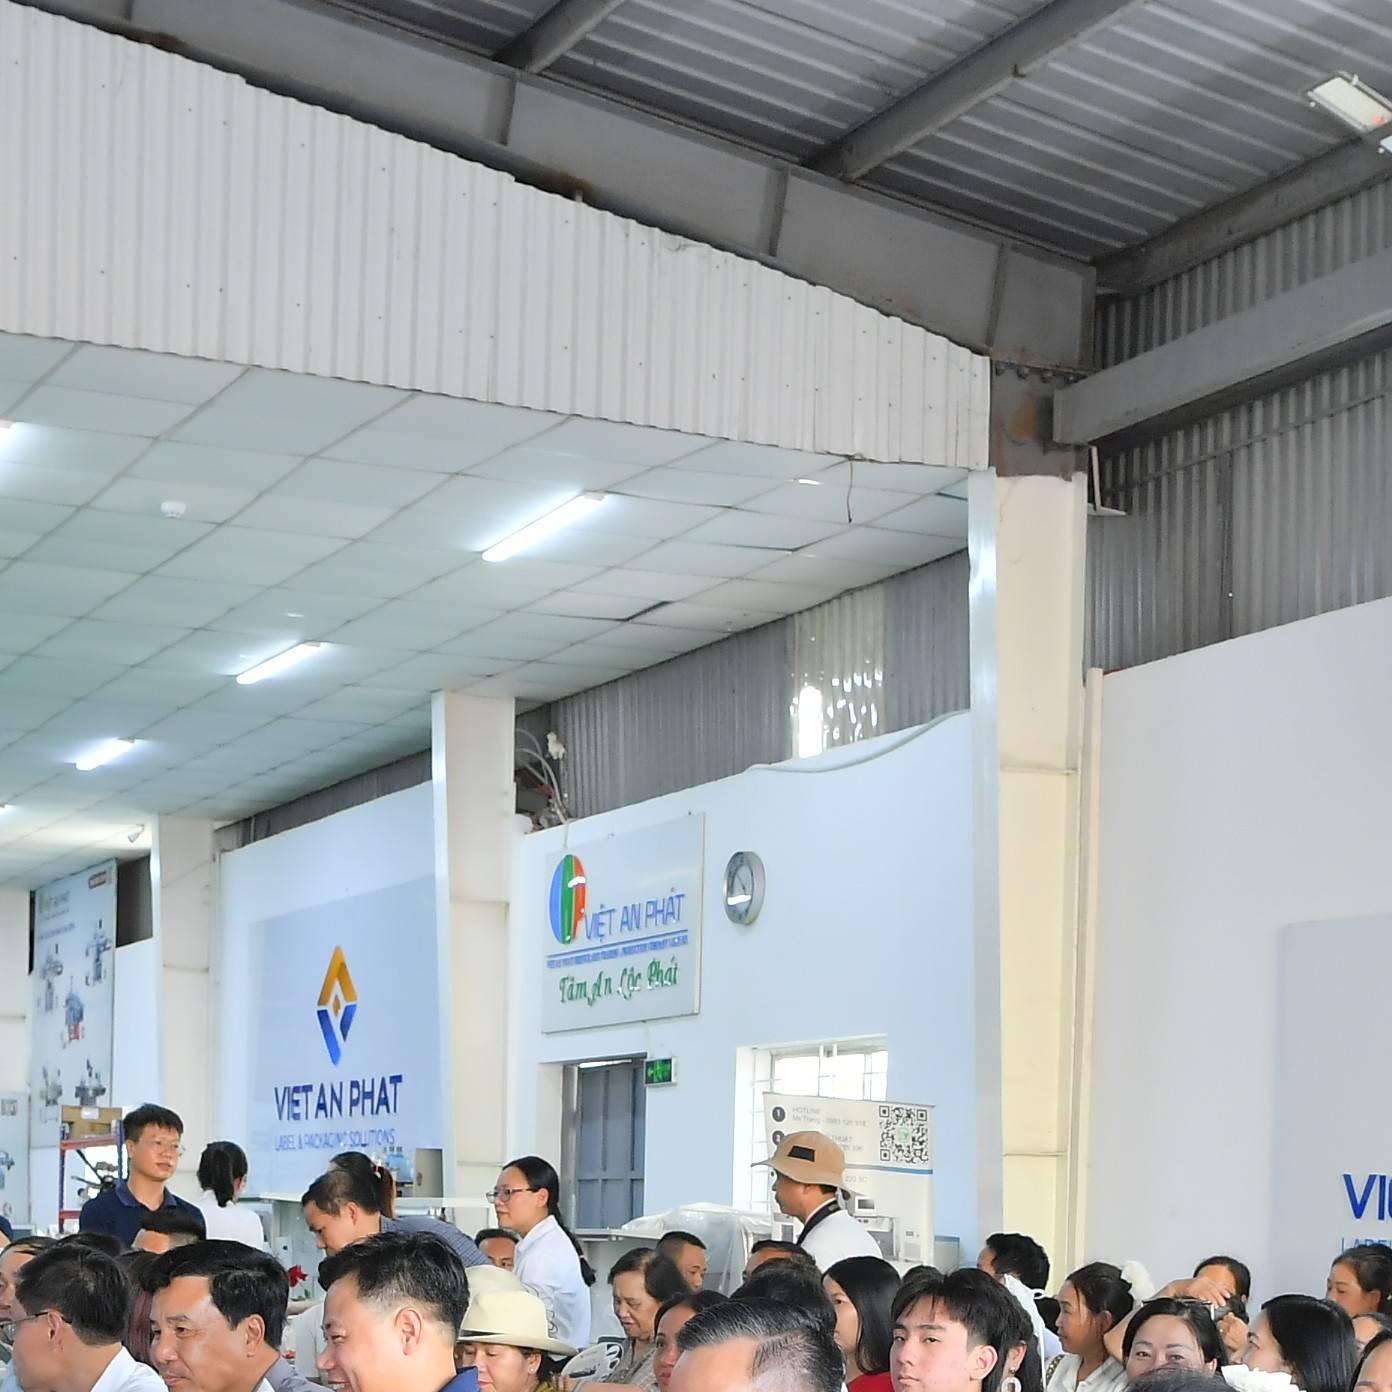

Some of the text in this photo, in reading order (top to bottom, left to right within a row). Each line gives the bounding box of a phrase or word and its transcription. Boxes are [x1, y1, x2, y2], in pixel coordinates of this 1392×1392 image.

[619, 903, 641, 933] AN
[274, 1074, 403, 1121] VIET AN PHAT
